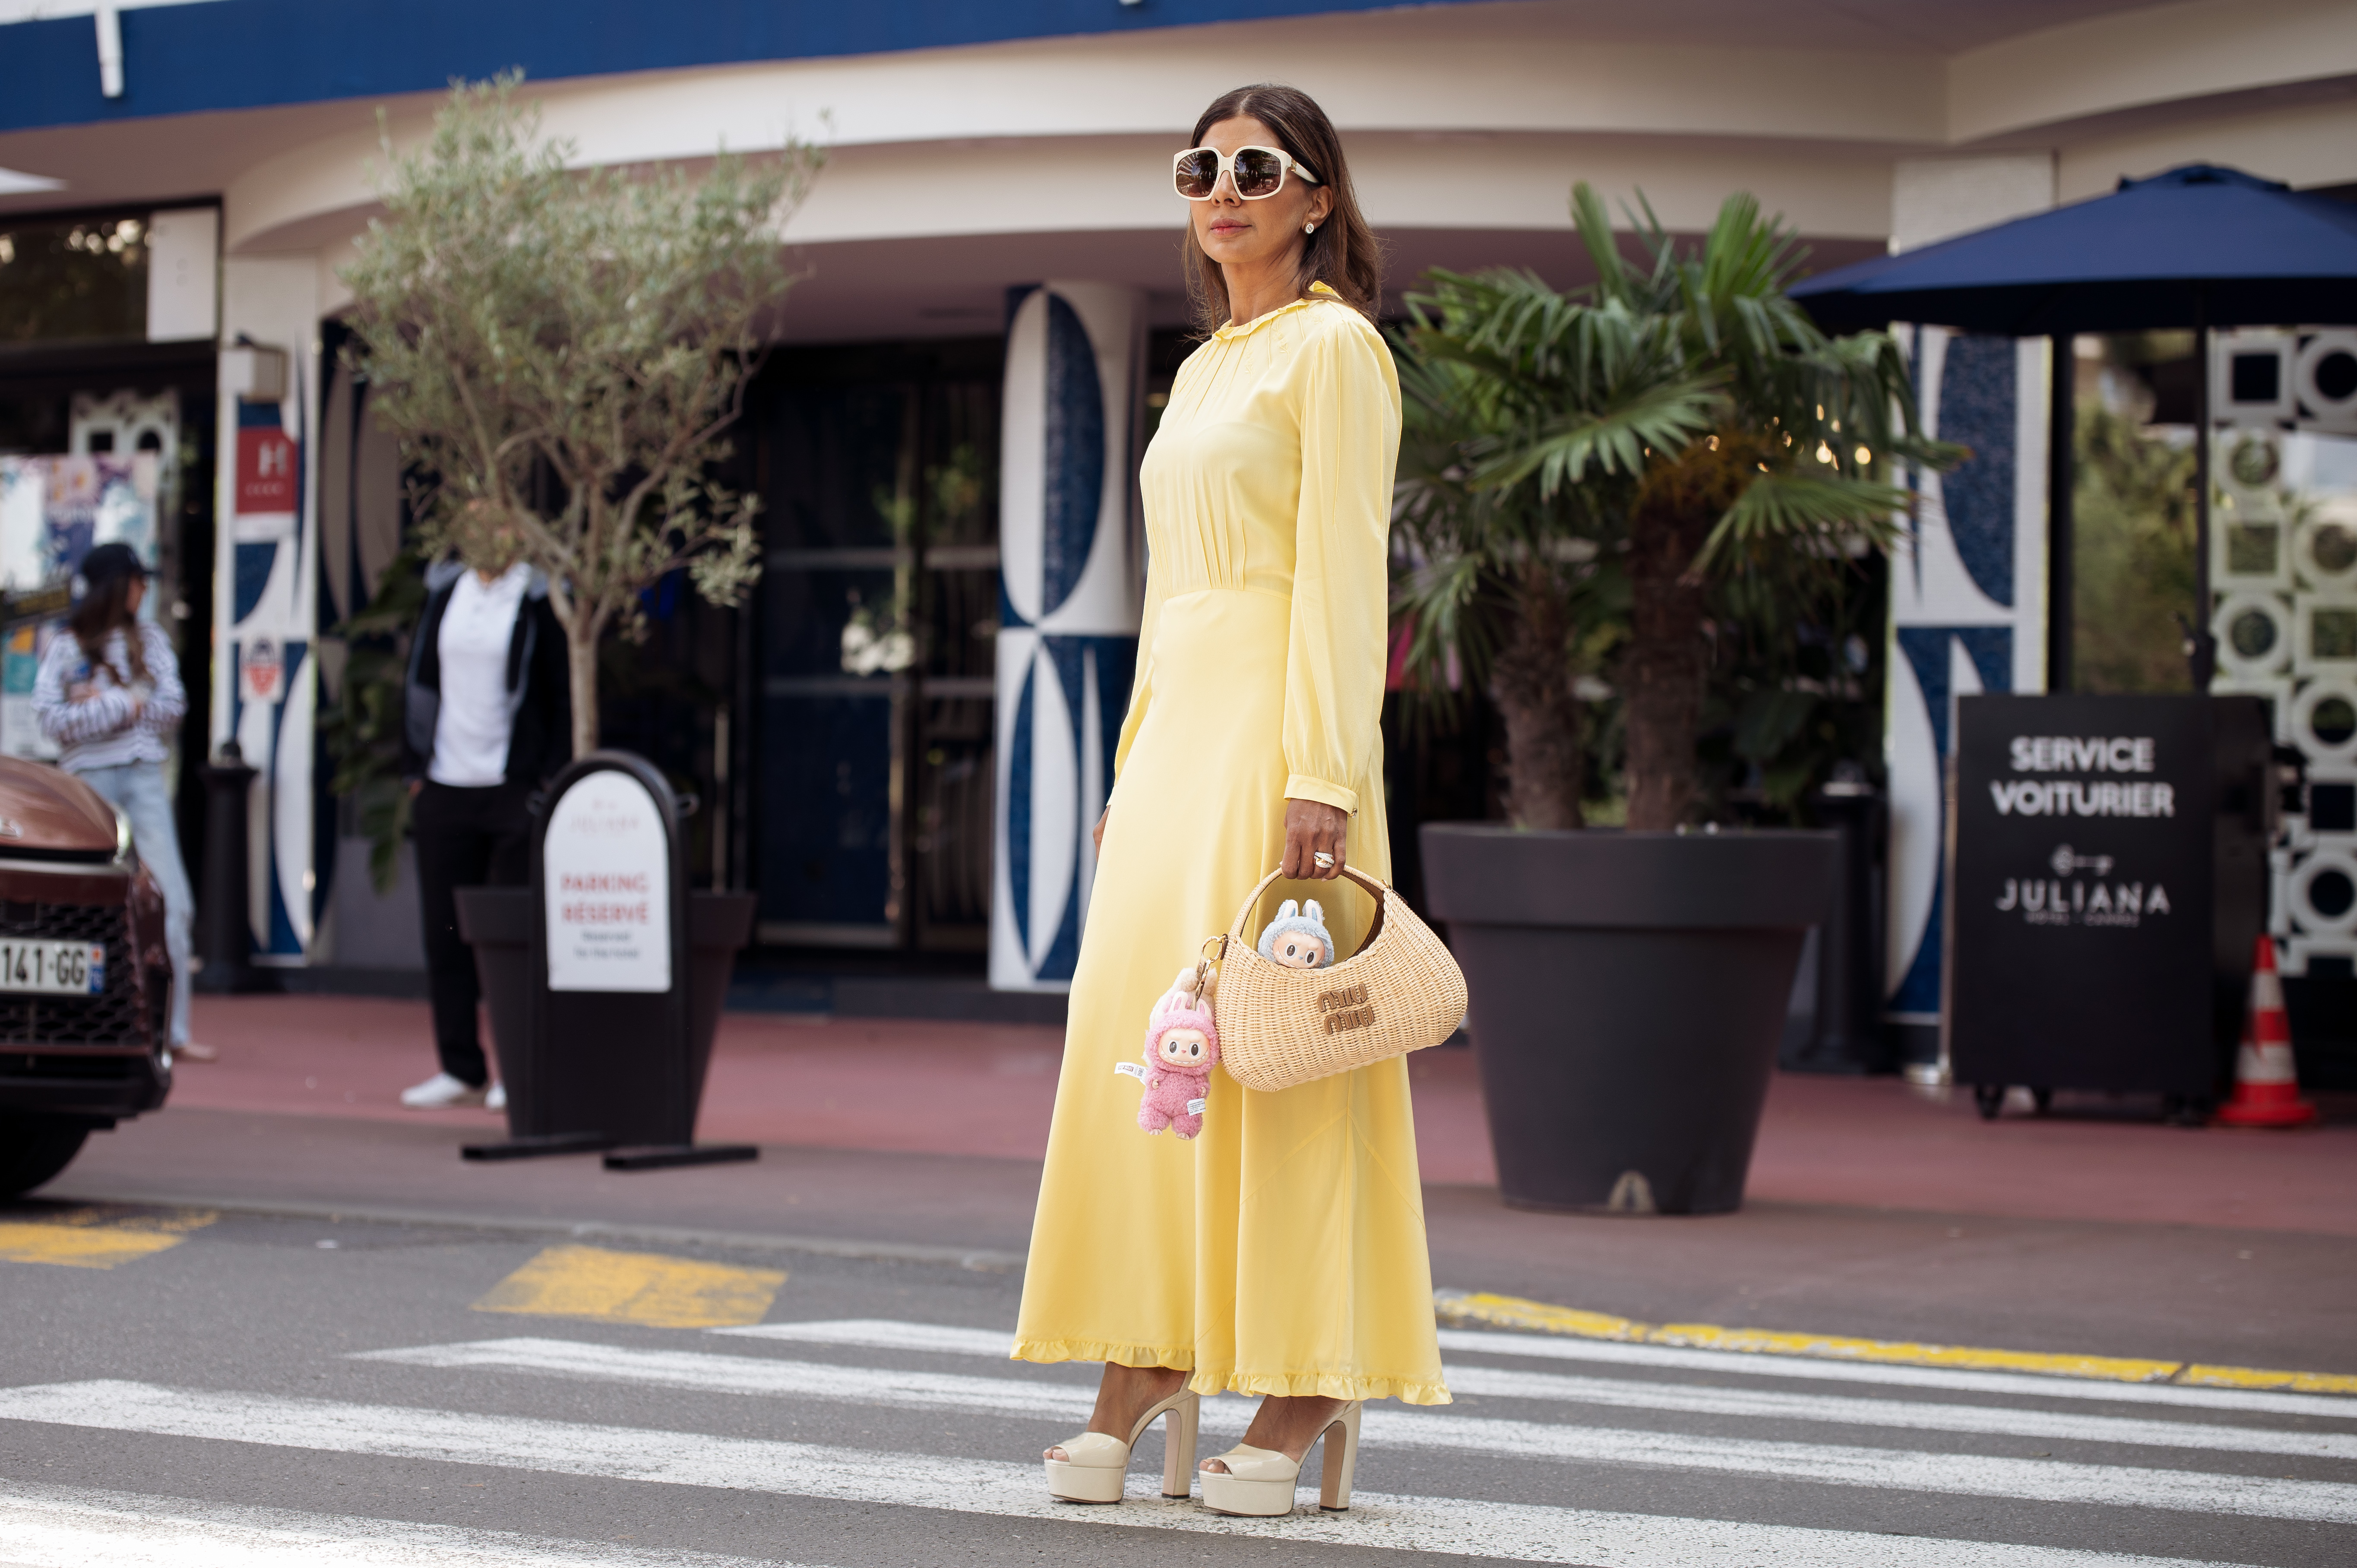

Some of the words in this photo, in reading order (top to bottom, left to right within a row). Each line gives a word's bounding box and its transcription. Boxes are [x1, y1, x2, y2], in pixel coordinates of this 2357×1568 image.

[2009, 736, 2155, 772] SERVICE
[1990, 780, 2175, 817] VOITURIER
[561, 873, 649, 892] PARKING
[1996, 879, 2170, 915] JULIANA
